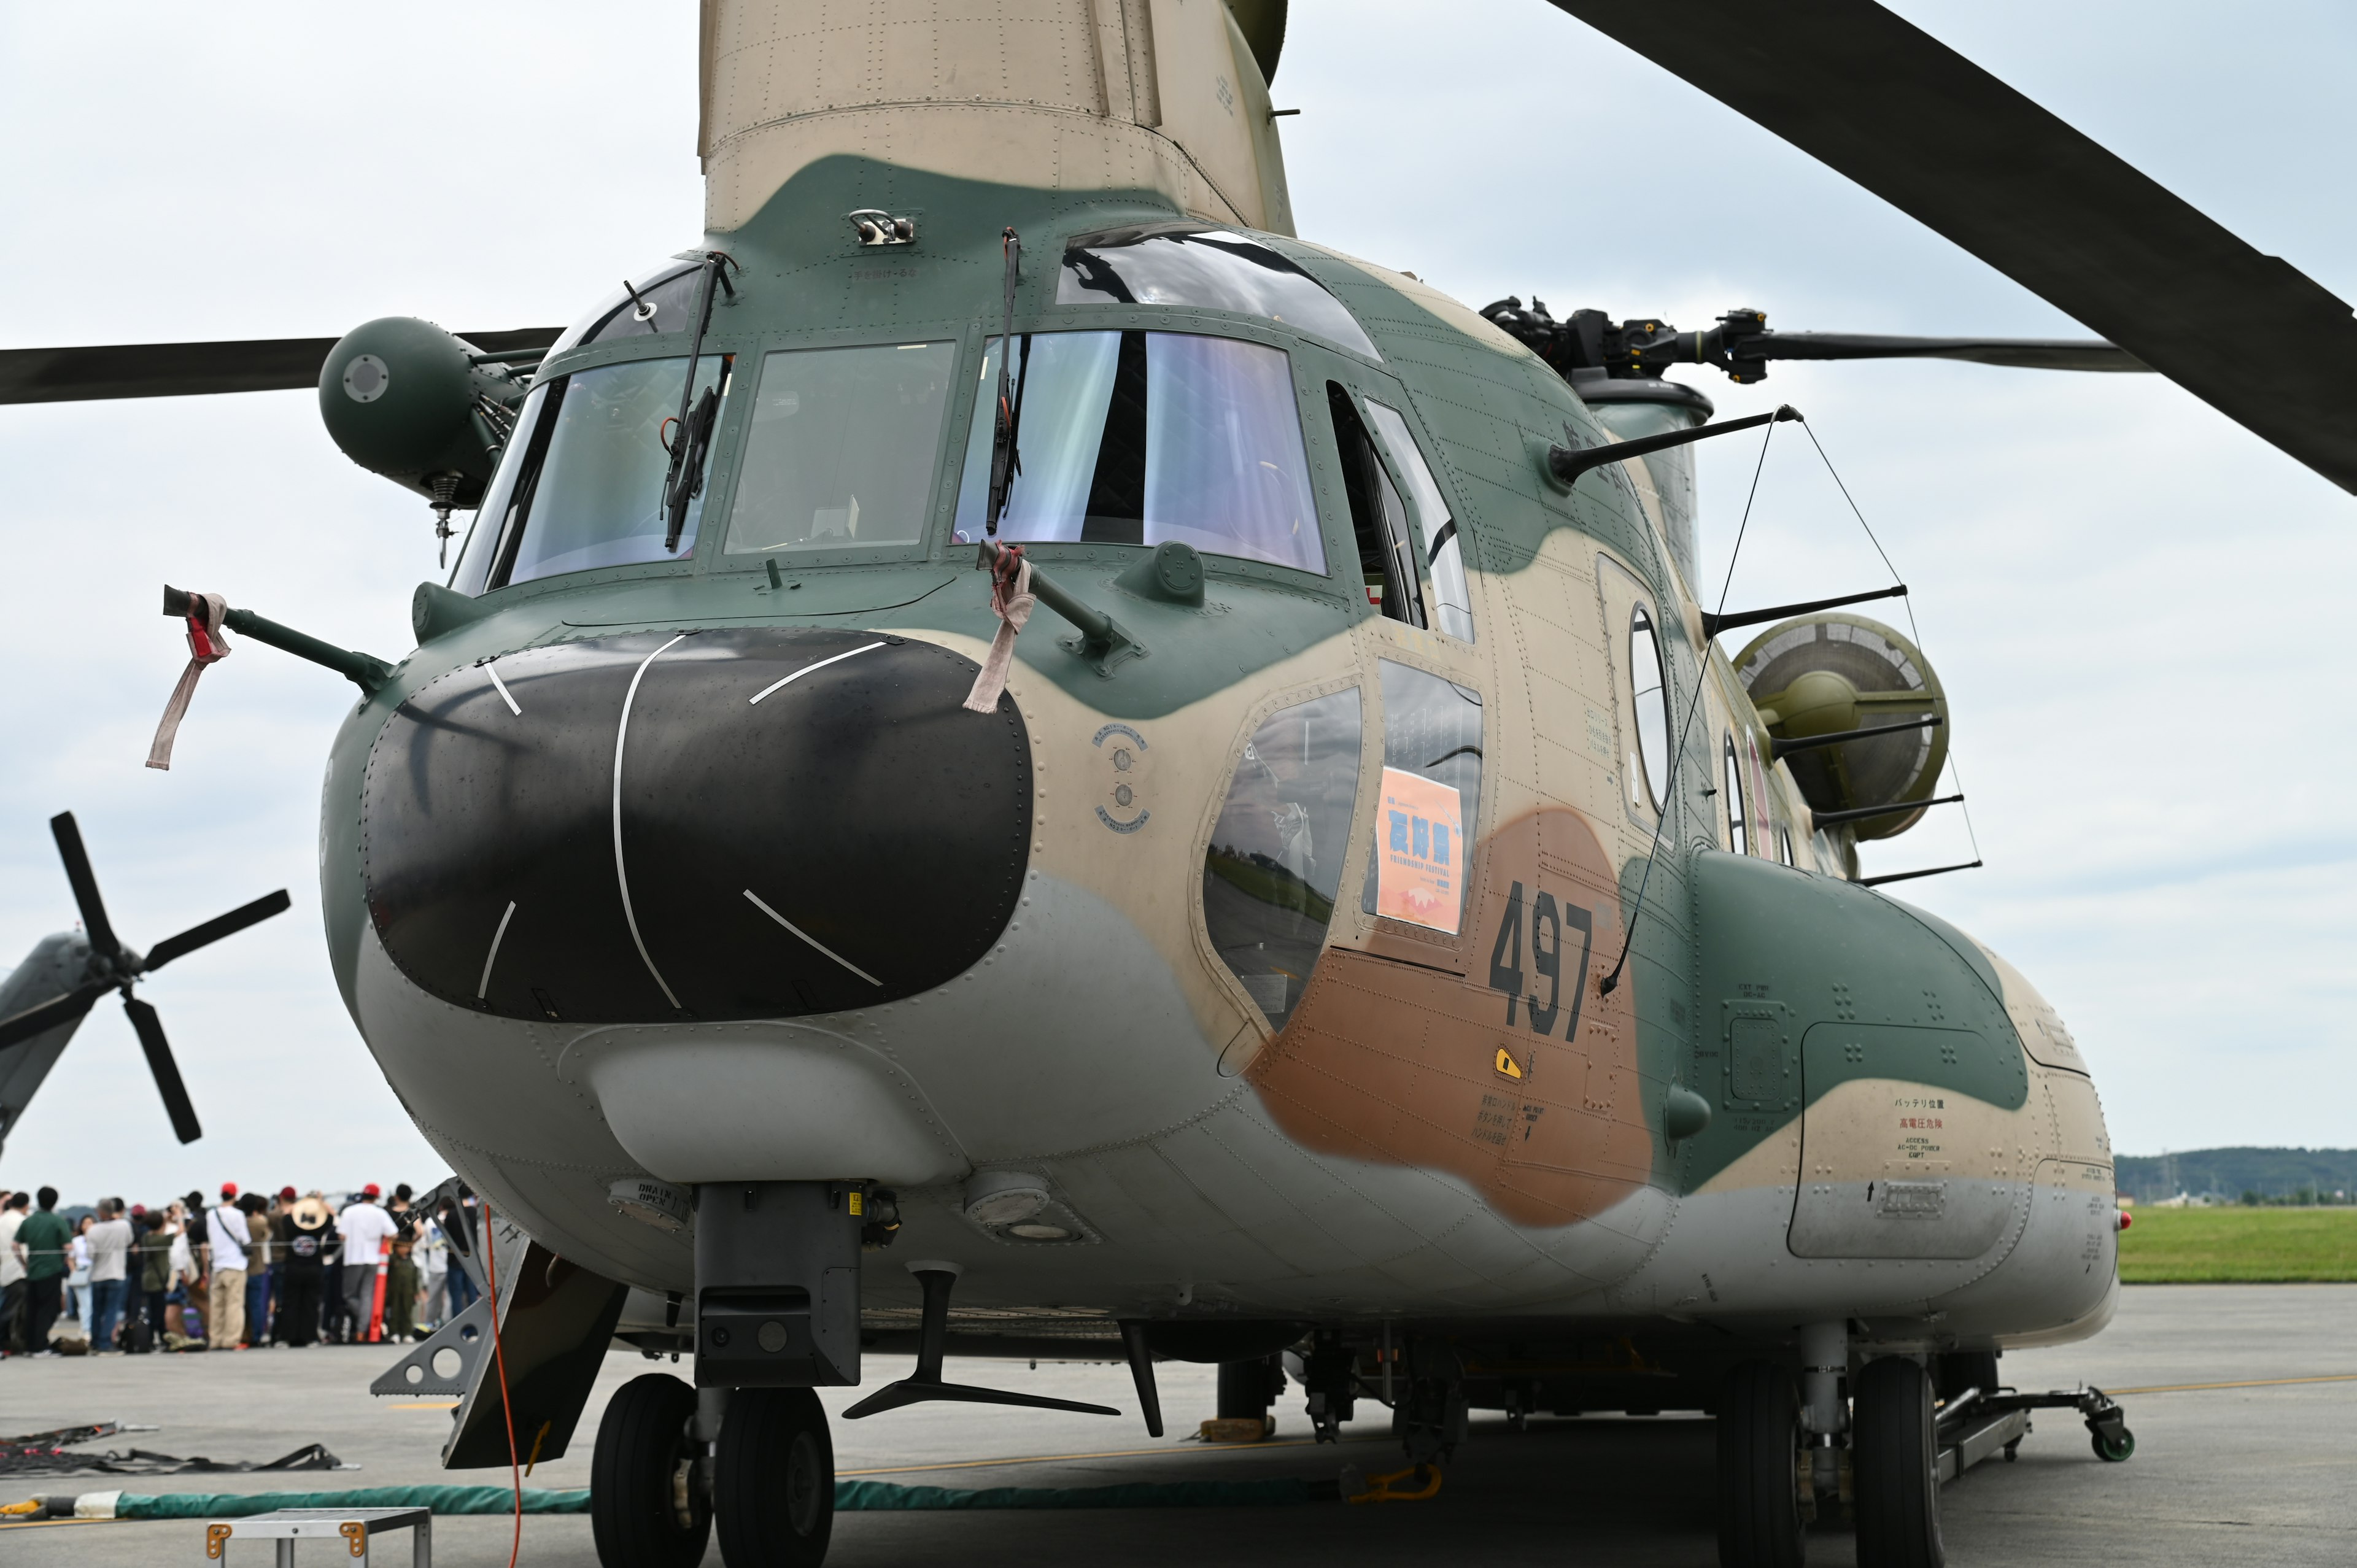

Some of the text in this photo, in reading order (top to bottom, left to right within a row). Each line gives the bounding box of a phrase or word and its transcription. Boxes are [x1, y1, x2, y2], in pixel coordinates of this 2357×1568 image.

[1388, 809, 1450, 866] 友好祭
[1390, 854, 1449, 878] FRIENDSHIP FESTIVAL
[1489, 880, 1592, 1043] 497
[1895, 1099, 1944, 1109] バッテリ位置
[1900, 1118, 1943, 1129] 高電圧危険
[639, 1184, 671, 1199] DRAIN
[640, 1193, 665, 1206] OPEN
